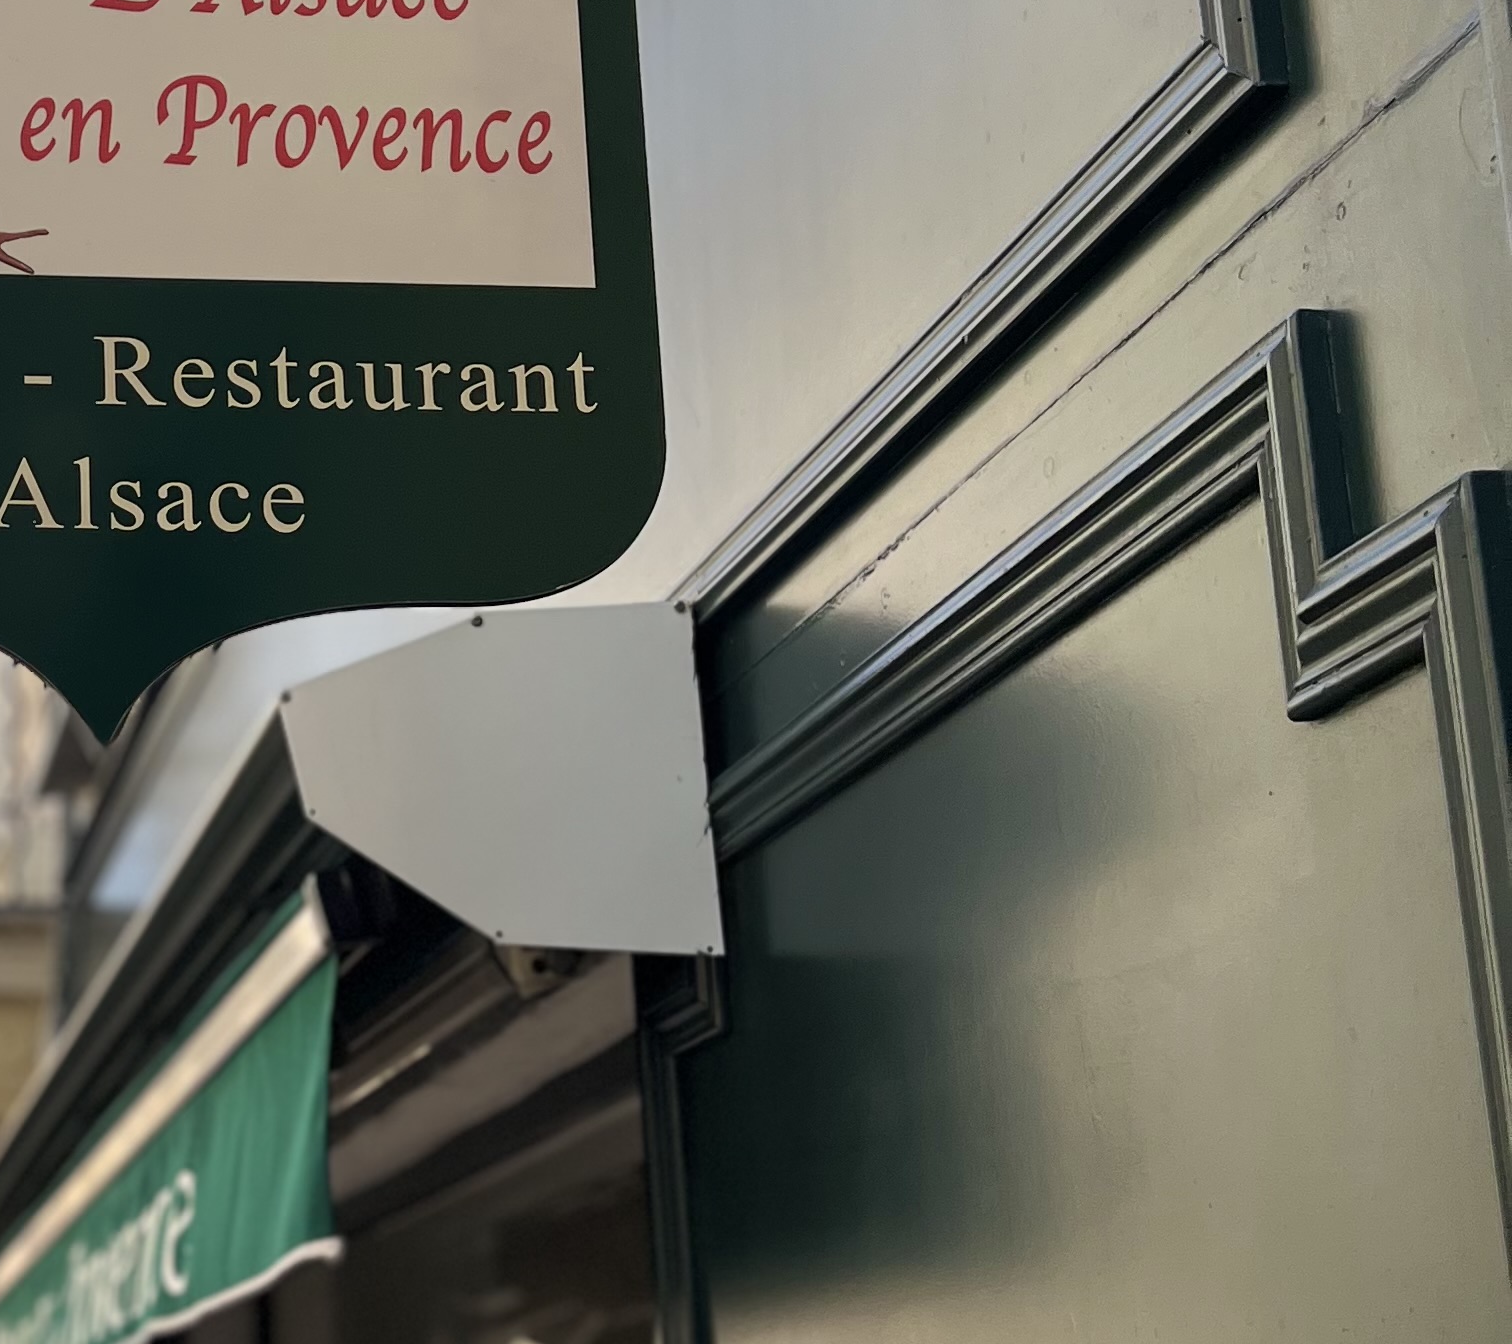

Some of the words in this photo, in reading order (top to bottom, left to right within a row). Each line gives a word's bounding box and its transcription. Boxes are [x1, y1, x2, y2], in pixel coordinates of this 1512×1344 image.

[19, 95, 121, 164] en
[157, 74, 553, 175] Provence
[93, 336, 599, 414] Restaurant
